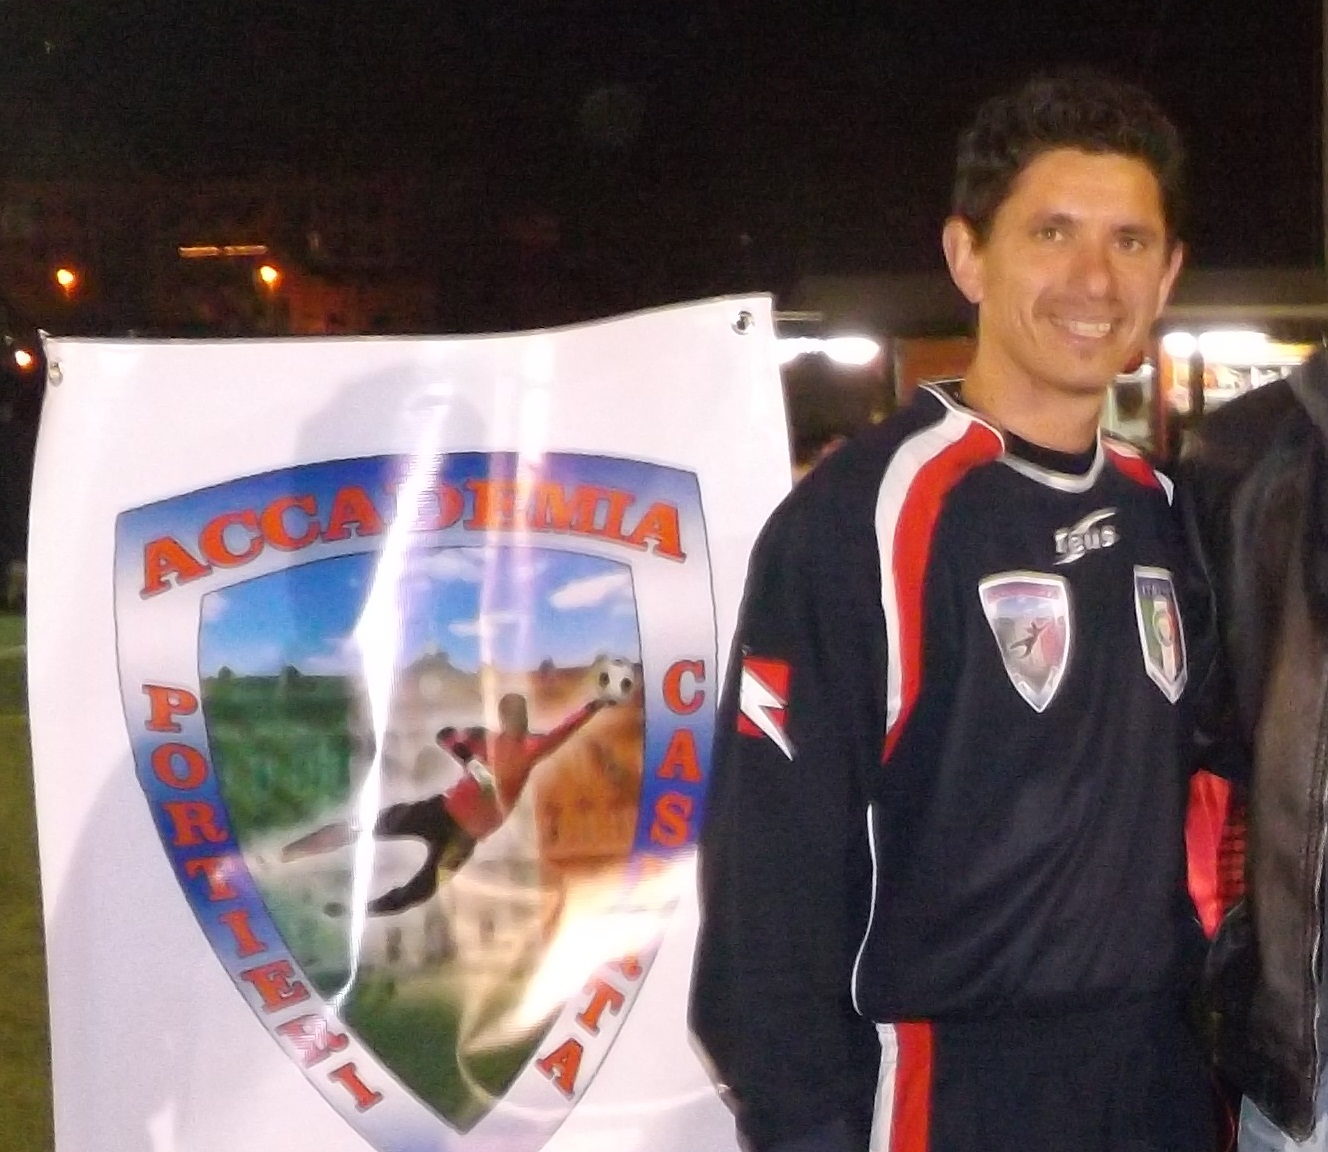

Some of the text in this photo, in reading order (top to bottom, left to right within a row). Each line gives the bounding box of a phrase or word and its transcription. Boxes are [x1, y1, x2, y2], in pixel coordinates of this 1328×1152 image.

[139, 477, 688, 599] ACCADEMIA
[142, 682, 384, 1114] PORTIERI
[534, 659, 706, 1099] CASTA
